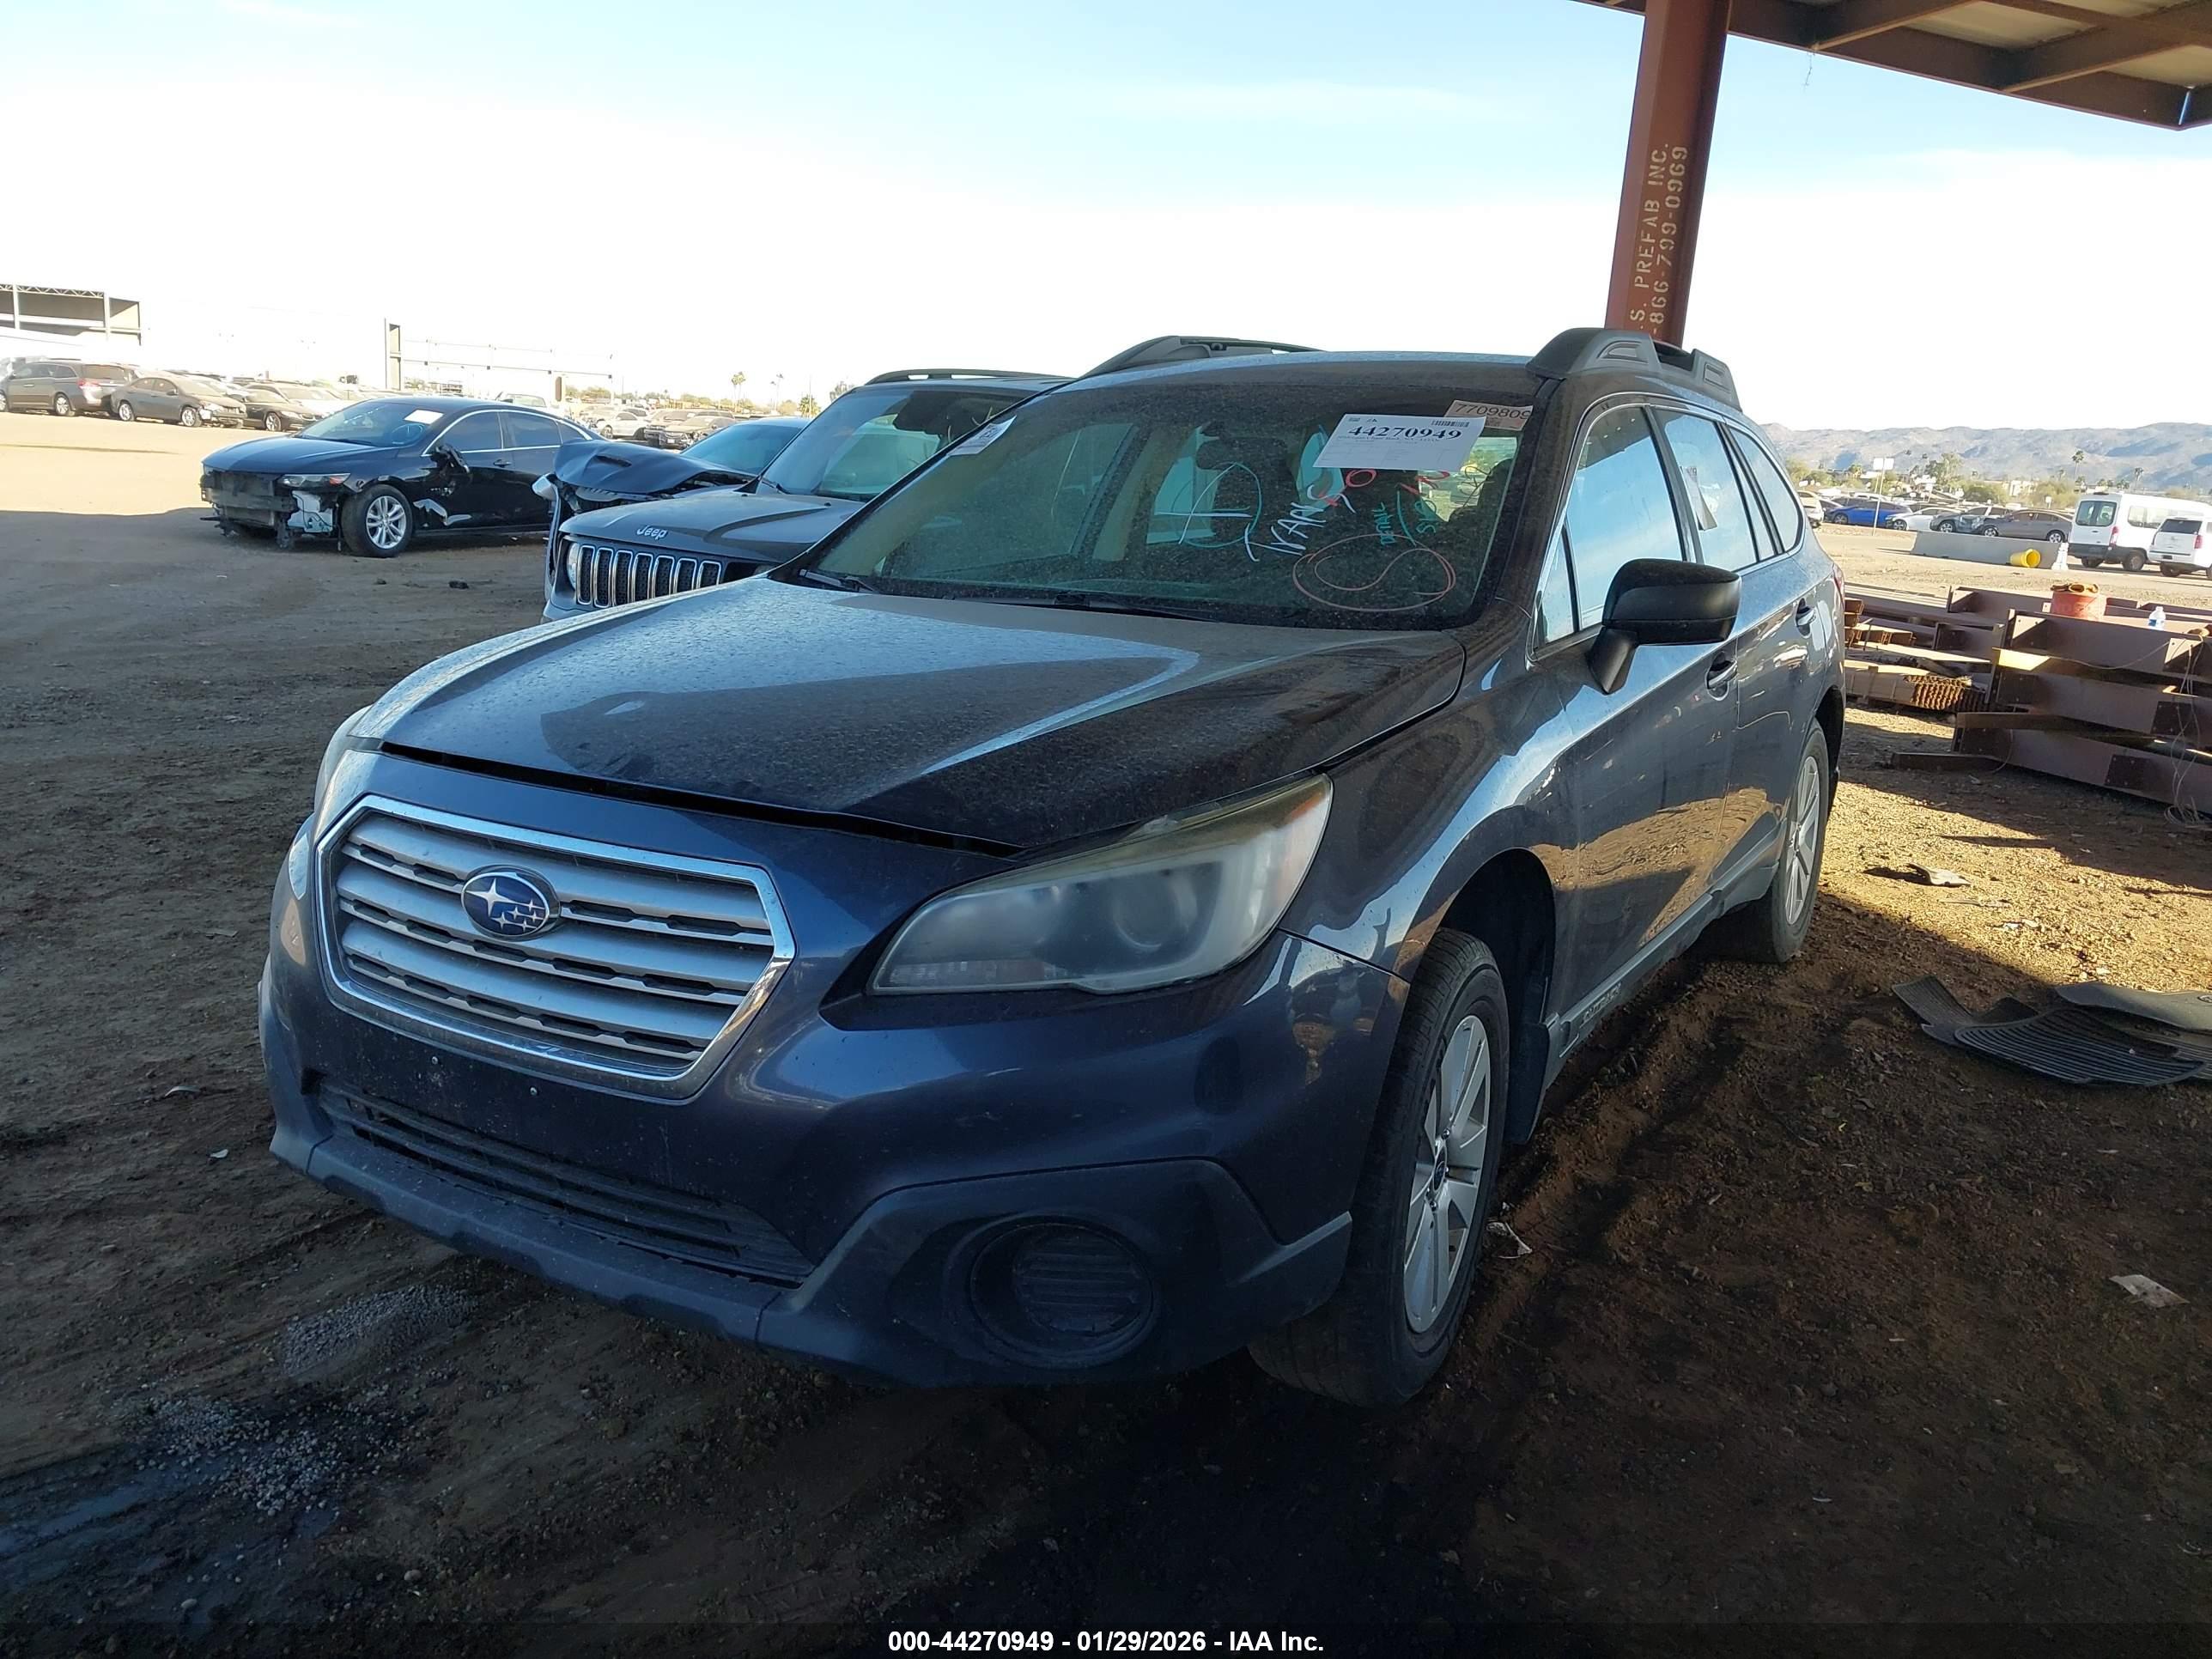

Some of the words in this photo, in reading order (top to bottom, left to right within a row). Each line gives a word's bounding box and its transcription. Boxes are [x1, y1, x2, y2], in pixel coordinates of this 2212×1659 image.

[1647, 143, 1669, 186] INC.
[1634, 199, 1661, 289] PREFAB
[1348, 425, 1462, 441] 44270949
[636, 525, 669, 540] Jeep
